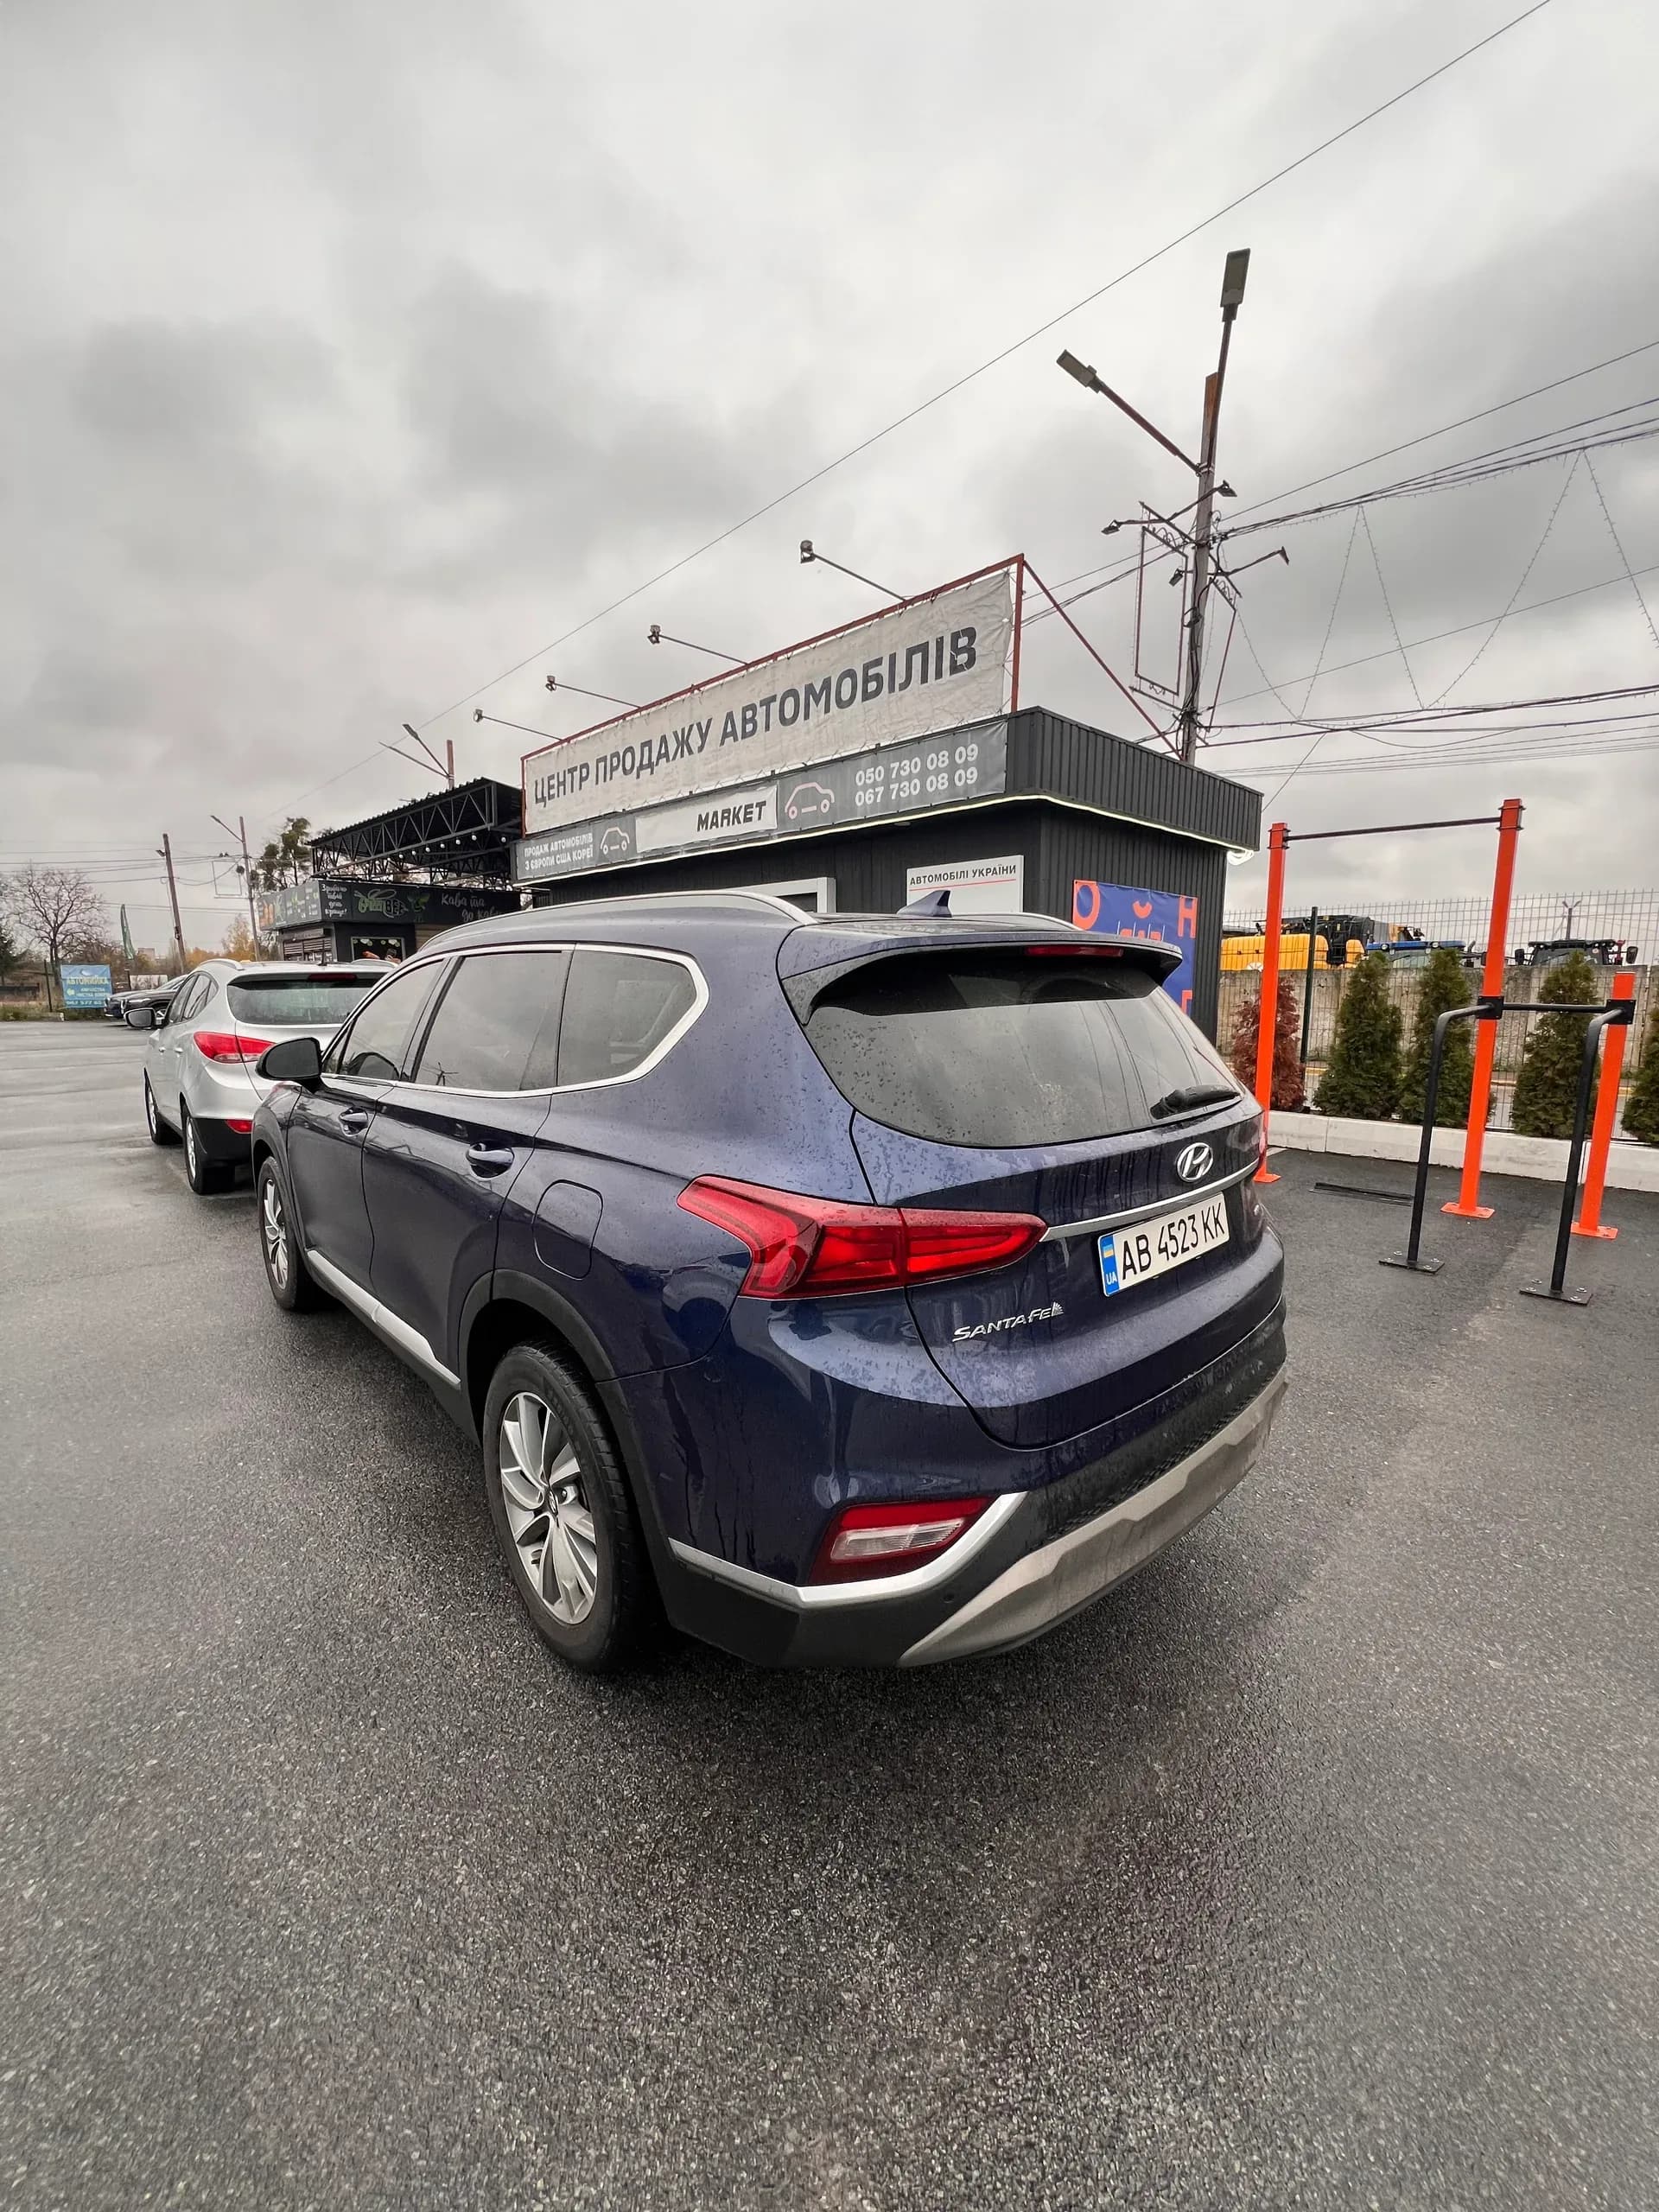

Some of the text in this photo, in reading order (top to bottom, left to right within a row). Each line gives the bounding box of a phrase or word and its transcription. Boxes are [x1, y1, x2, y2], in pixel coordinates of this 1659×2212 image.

[534, 626, 977, 809] ЦЕНТР ПРОДАЖУ АВТОМОБІЛІВ
[855, 744, 978, 786] 050 730 08 09
[855, 766, 978, 807] 067 730 08 09
[696, 801, 766, 832] MARKET
[524, 833, 594, 857] ПРОДАЖ АВТОМОБІЛІВ
[531, 855, 556, 869] ЄВРОПИ
[556, 853, 571, 864] США
[572, 845, 594, 861] КОРЕЇ
[910, 864, 1017, 886] АВТОМОБІЛІ УКРАЇНИ
[1122, 1203, 1225, 1280] AB 4523 KK
[1106, 1271, 1117, 1285] UA
